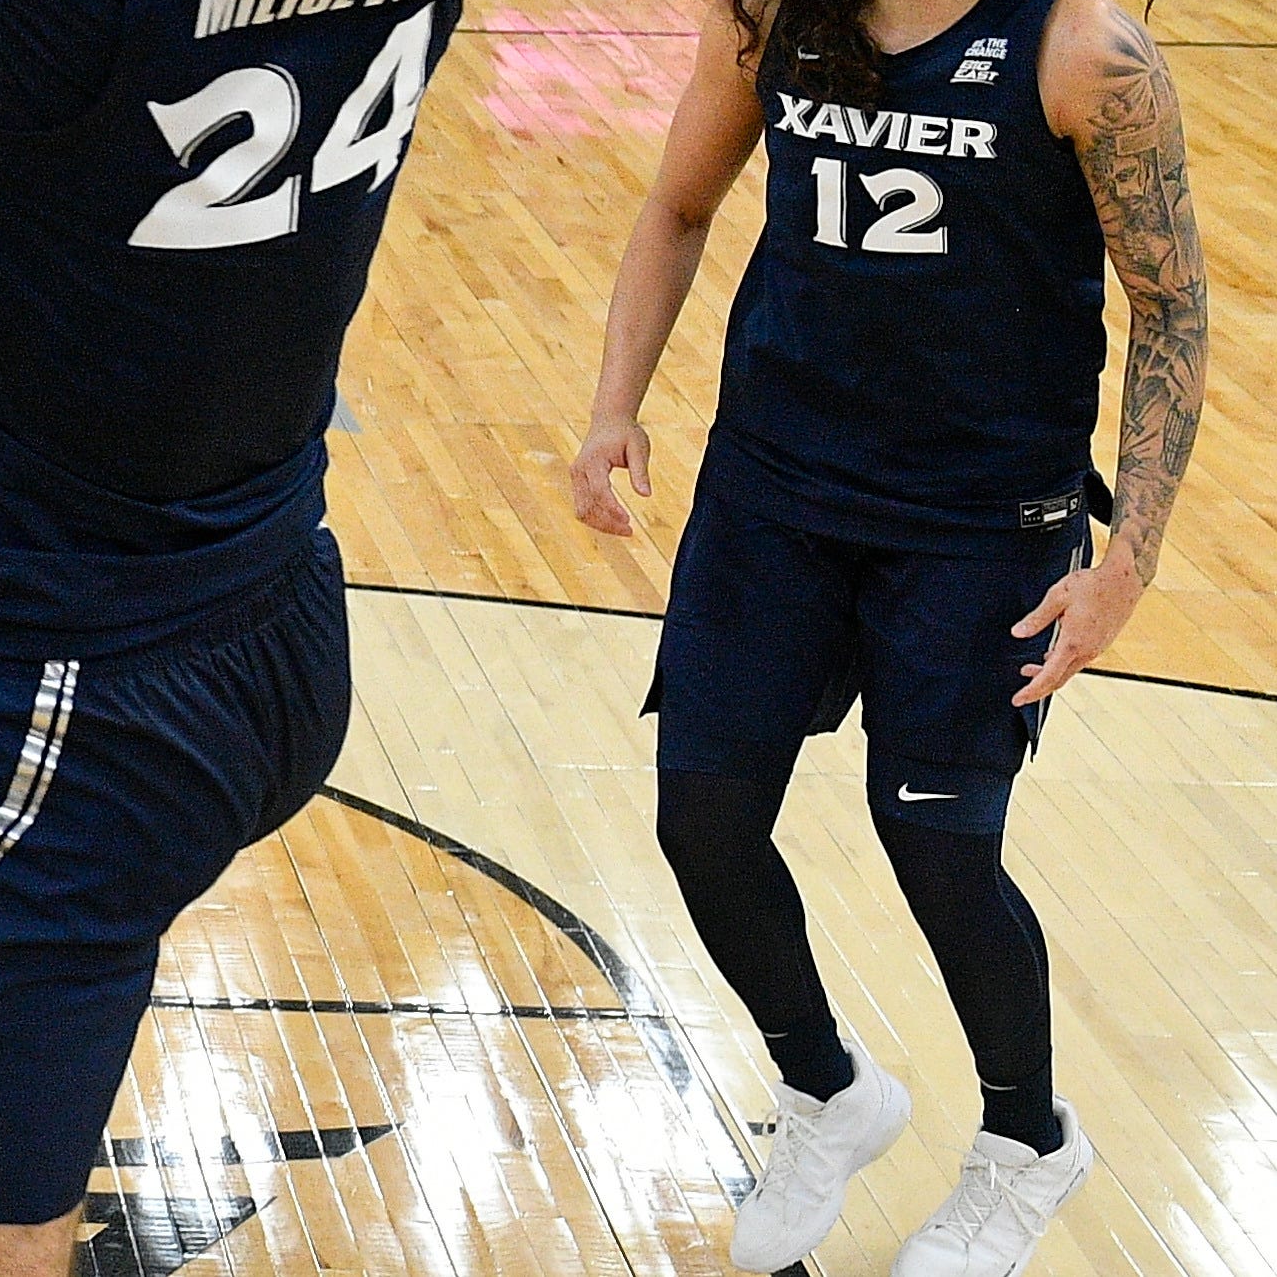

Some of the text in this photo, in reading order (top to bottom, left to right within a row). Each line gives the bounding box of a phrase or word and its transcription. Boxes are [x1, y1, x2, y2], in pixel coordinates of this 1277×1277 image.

[954, 68, 1000, 82] EAST
[959, 59, 993, 71] BIG
[127, 0, 436, 250] 24
[774, 91, 999, 159] XAVIER
[810, 157, 948, 254] 12
